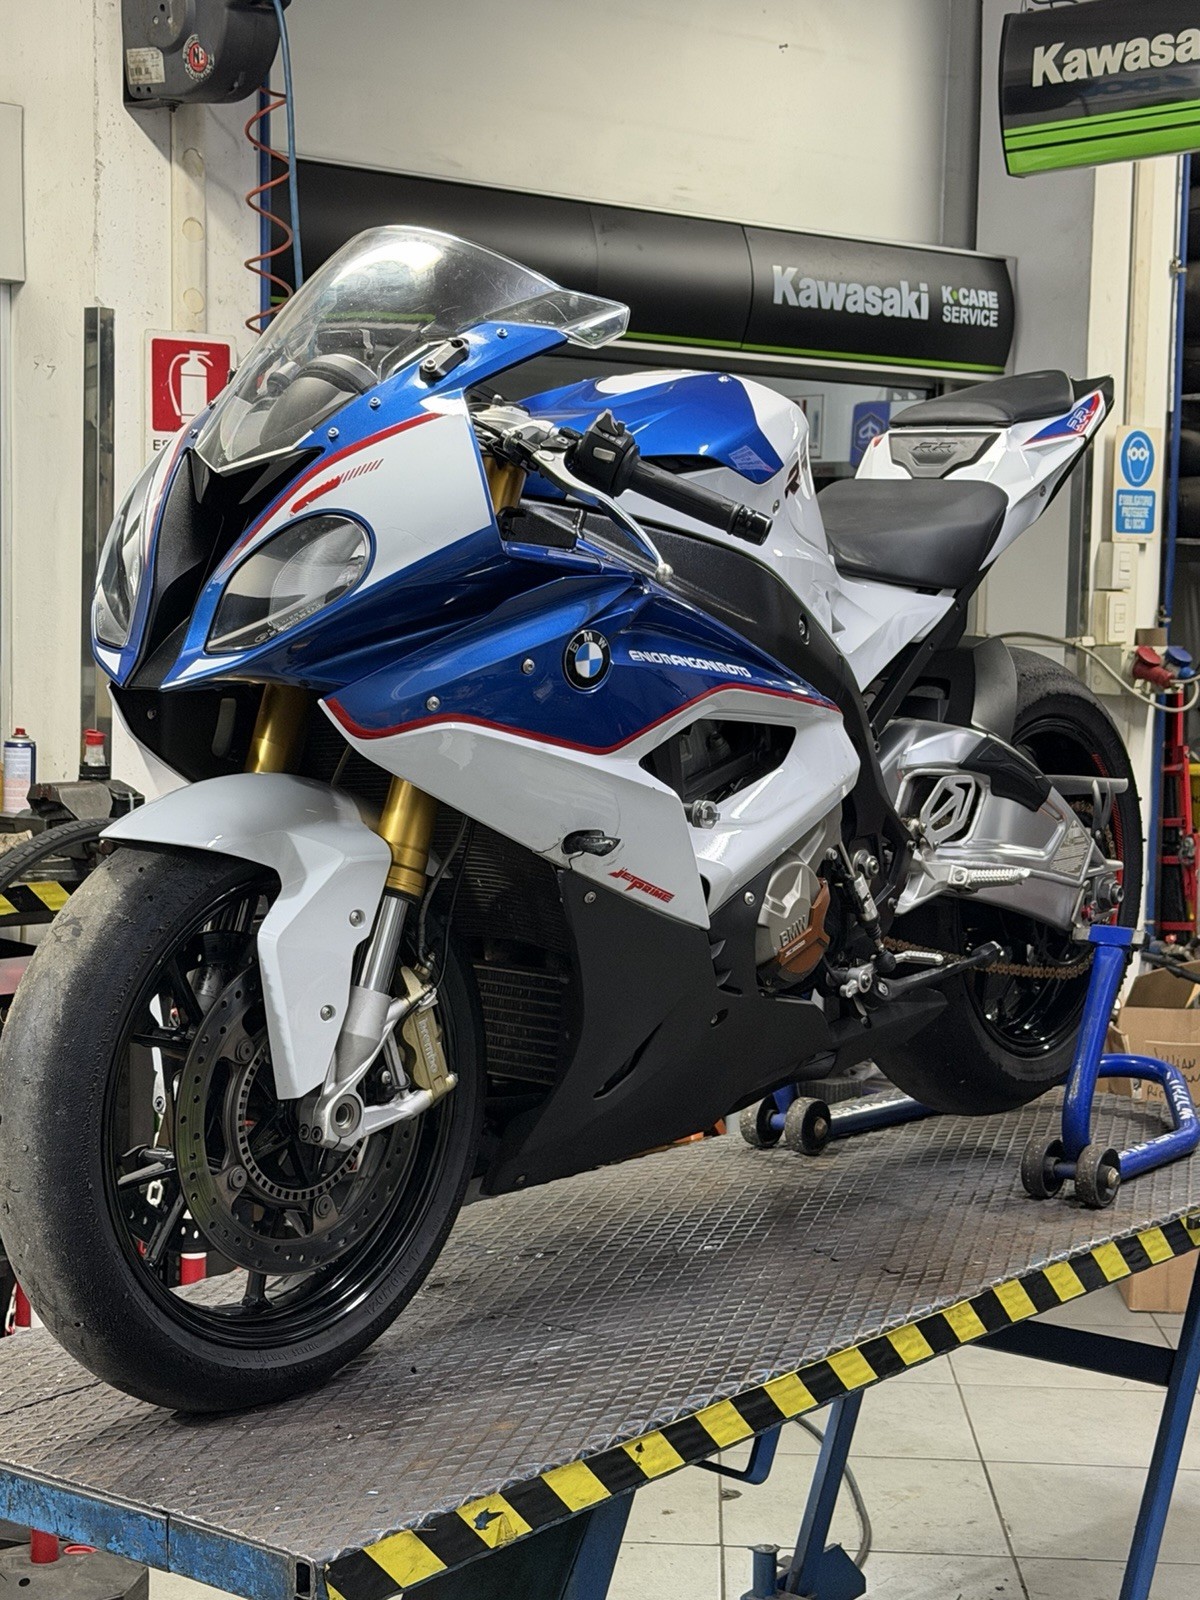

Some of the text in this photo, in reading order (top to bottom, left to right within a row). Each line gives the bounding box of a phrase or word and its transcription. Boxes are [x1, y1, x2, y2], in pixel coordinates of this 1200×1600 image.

[1032, 28, 1200, 87] Kawasa
[772, 265, 929, 320] Kawasaki
[942, 306, 999, 328] SERVICE
[779, 914, 808, 947] BMW
[418, 1017, 438, 1074] brembo
